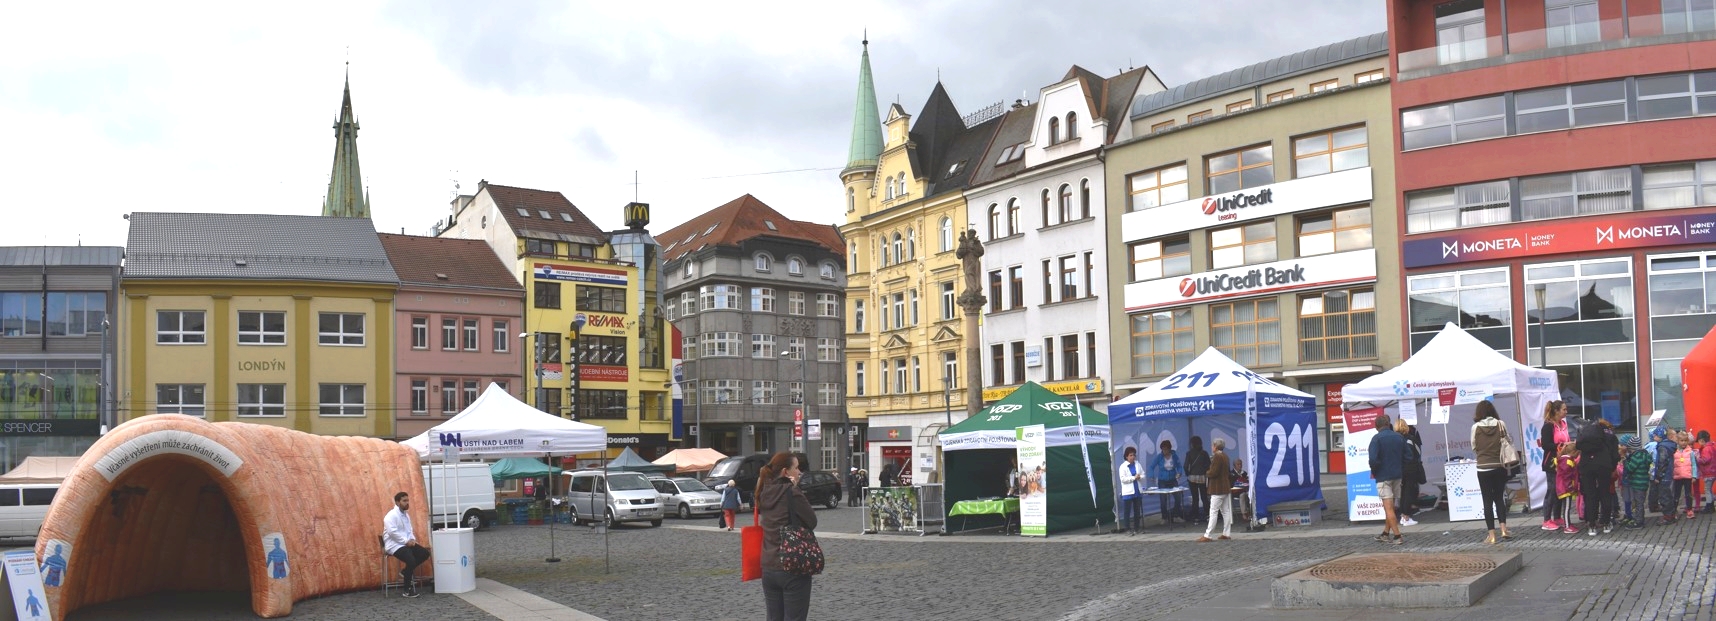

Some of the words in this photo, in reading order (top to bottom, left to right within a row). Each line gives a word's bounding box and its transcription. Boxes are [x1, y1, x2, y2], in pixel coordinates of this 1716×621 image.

[1217, 188, 1272, 212] UniCredit
[1218, 212, 1237, 221] Leasing
[1619, 224, 1681, 240] MONETA
[1463, 237, 1522, 253] MONETA
[1197, 268, 1262, 294] UniCredit
[1265, 264, 1306, 286] Bank
[588, 314, 624, 328] RE/MAX
[238, 358, 286, 371] LONDÝN
[1160, 372, 1220, 390] 211
[1199, 400, 1214, 410] 211
[4, 422, 52, 432] SPENCER
[106, 454, 129, 474] Včasné
[130, 440, 160, 459] vyšetření
[162, 439, 180, 448] může
[182, 443, 214, 459] zachránit
[212, 455, 230, 469] život
[1264, 422, 1315, 488] 211
